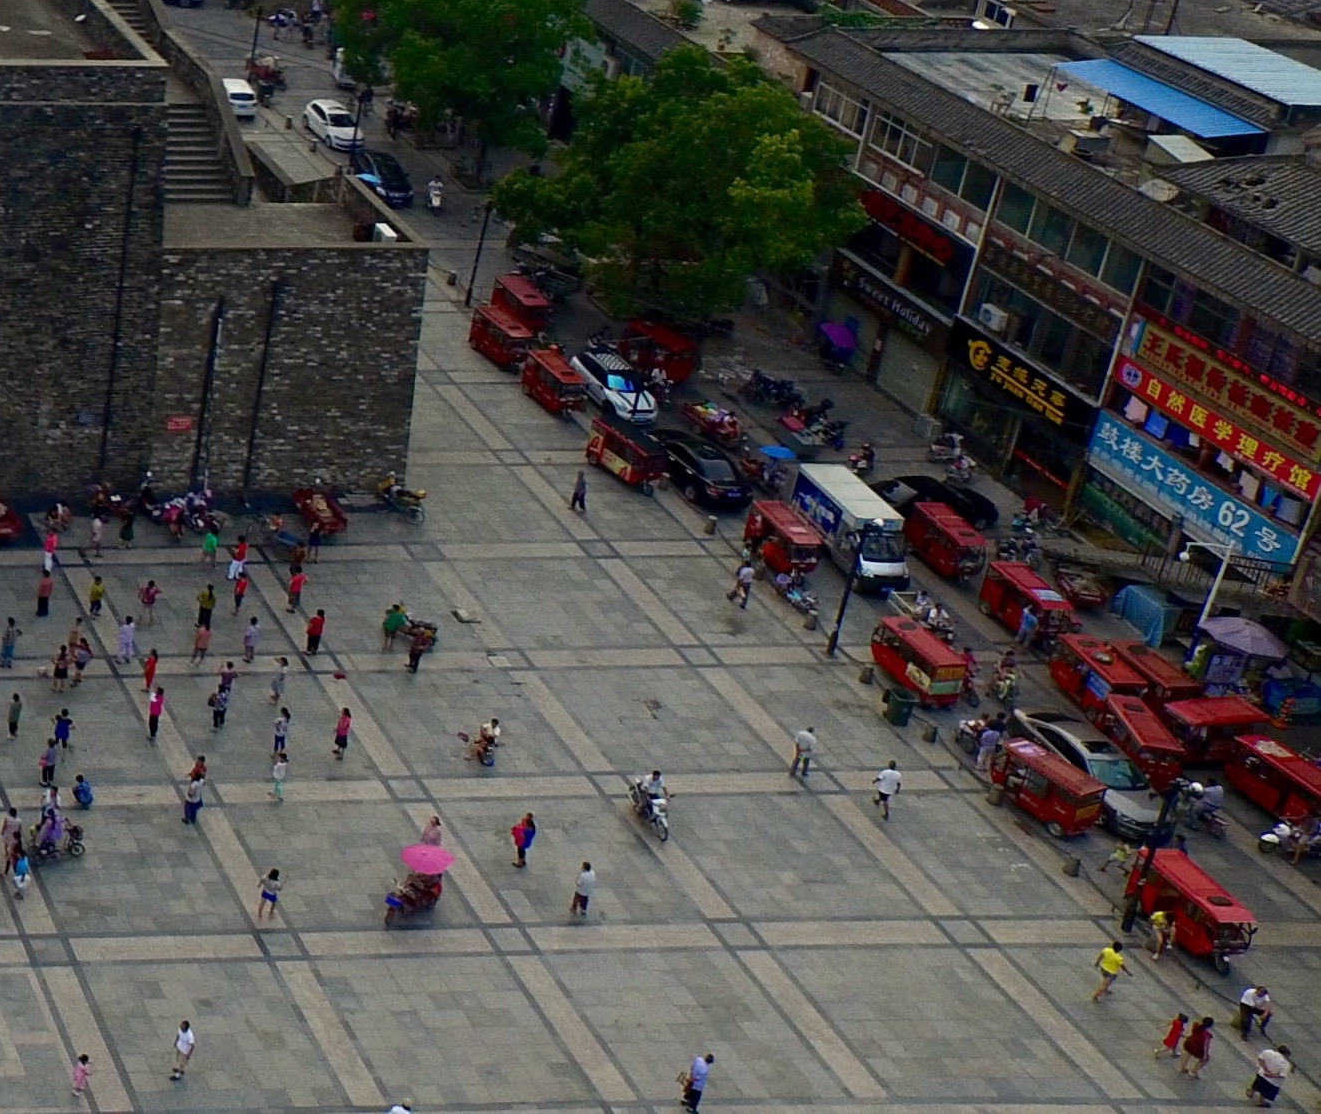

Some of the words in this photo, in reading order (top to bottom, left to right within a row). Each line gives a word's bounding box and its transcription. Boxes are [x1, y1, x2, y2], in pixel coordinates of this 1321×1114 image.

[858, 276, 891, 307] Sweet
[891, 298, 932, 337] Holiday
[1146, 378, 1313, 492] 自然医学理疗馆
